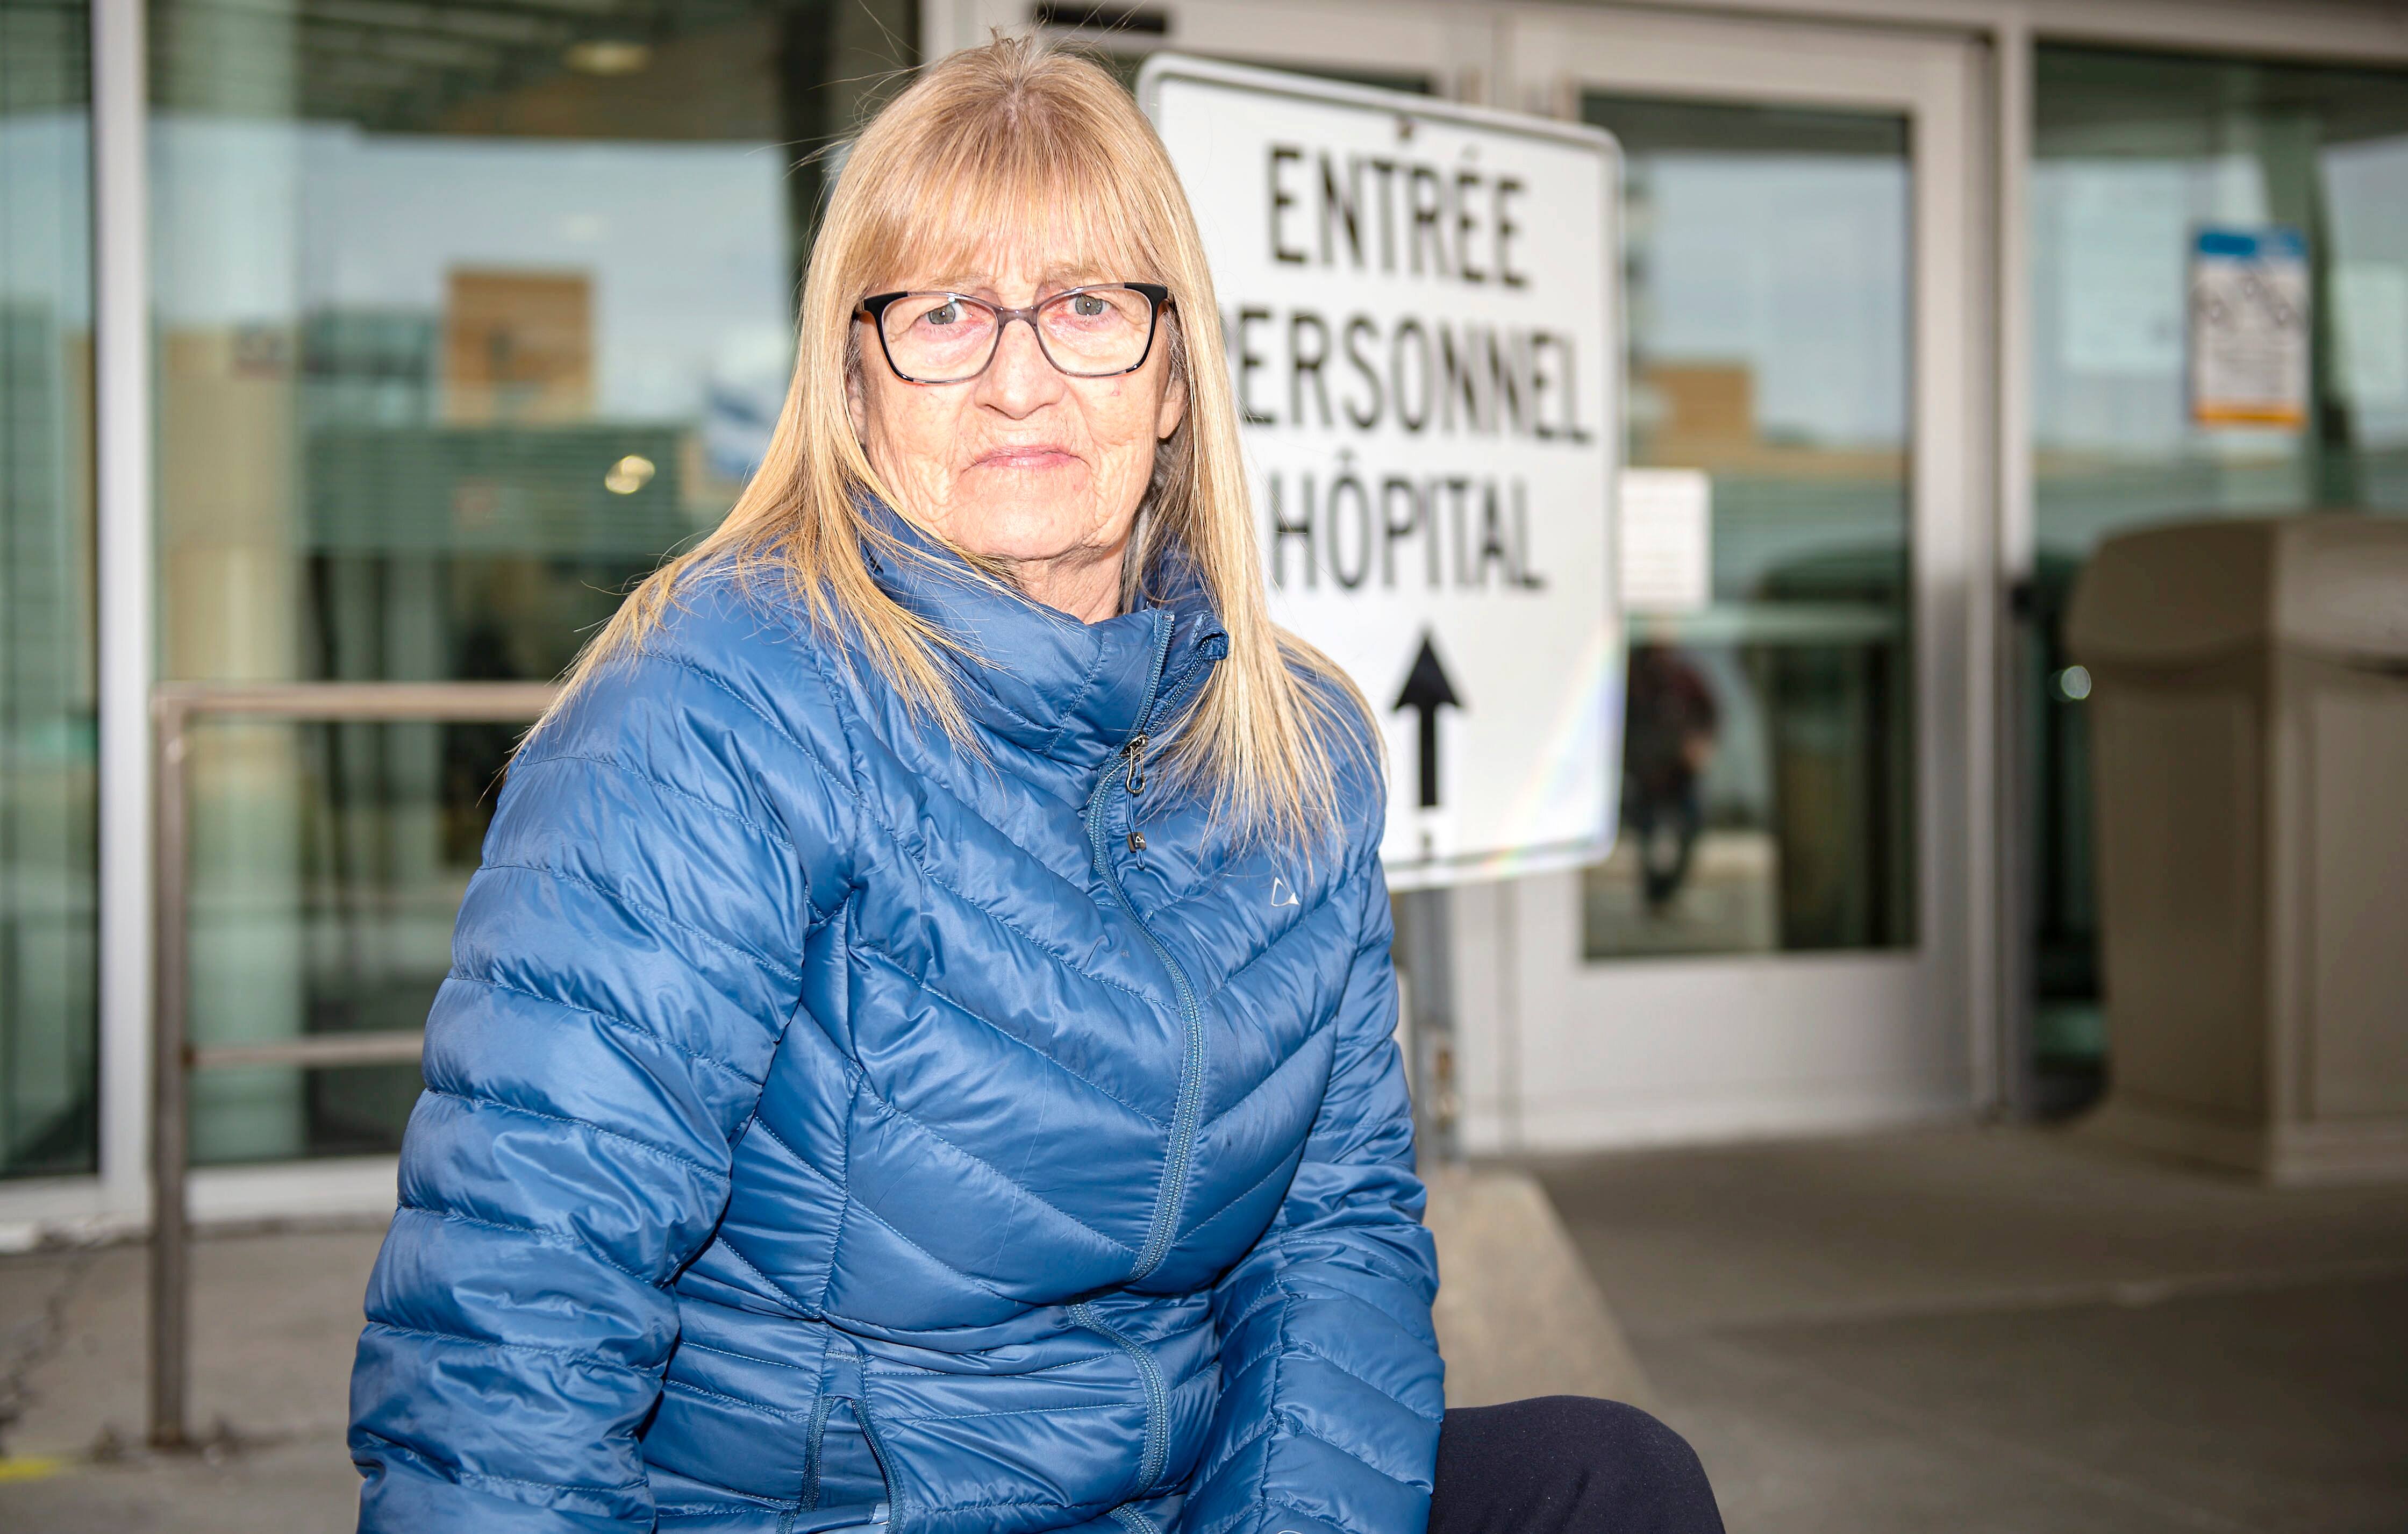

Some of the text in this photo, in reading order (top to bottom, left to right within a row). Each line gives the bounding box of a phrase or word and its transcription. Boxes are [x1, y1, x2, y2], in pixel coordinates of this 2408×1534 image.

[1268, 142, 1528, 289] ENTRÉE
[1219, 303, 1596, 444] ERSONNEL
[1269, 447, 1547, 593] HÔPITAL
